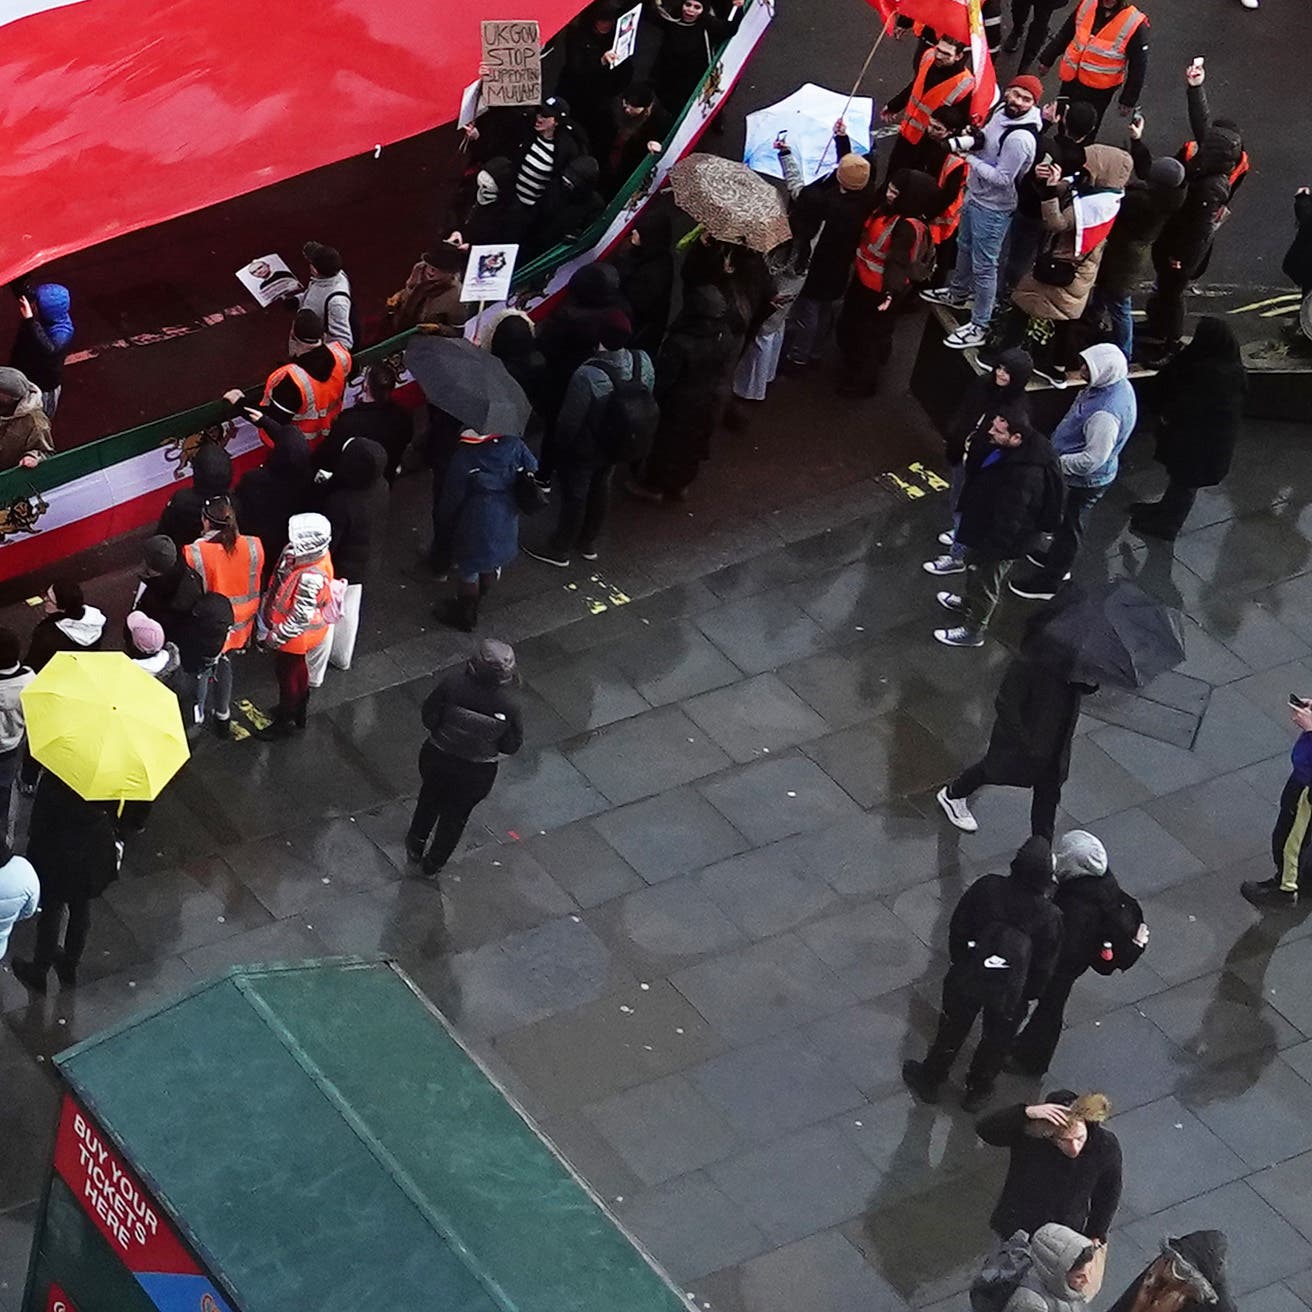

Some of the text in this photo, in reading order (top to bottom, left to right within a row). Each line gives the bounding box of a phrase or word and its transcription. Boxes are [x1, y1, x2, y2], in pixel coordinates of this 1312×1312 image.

[487, 47, 536, 67] STOP
[73, 1113, 159, 1235] BUY YOUR
[79, 1142, 146, 1246] TICKETS
[84, 1178, 131, 1251] HERE
